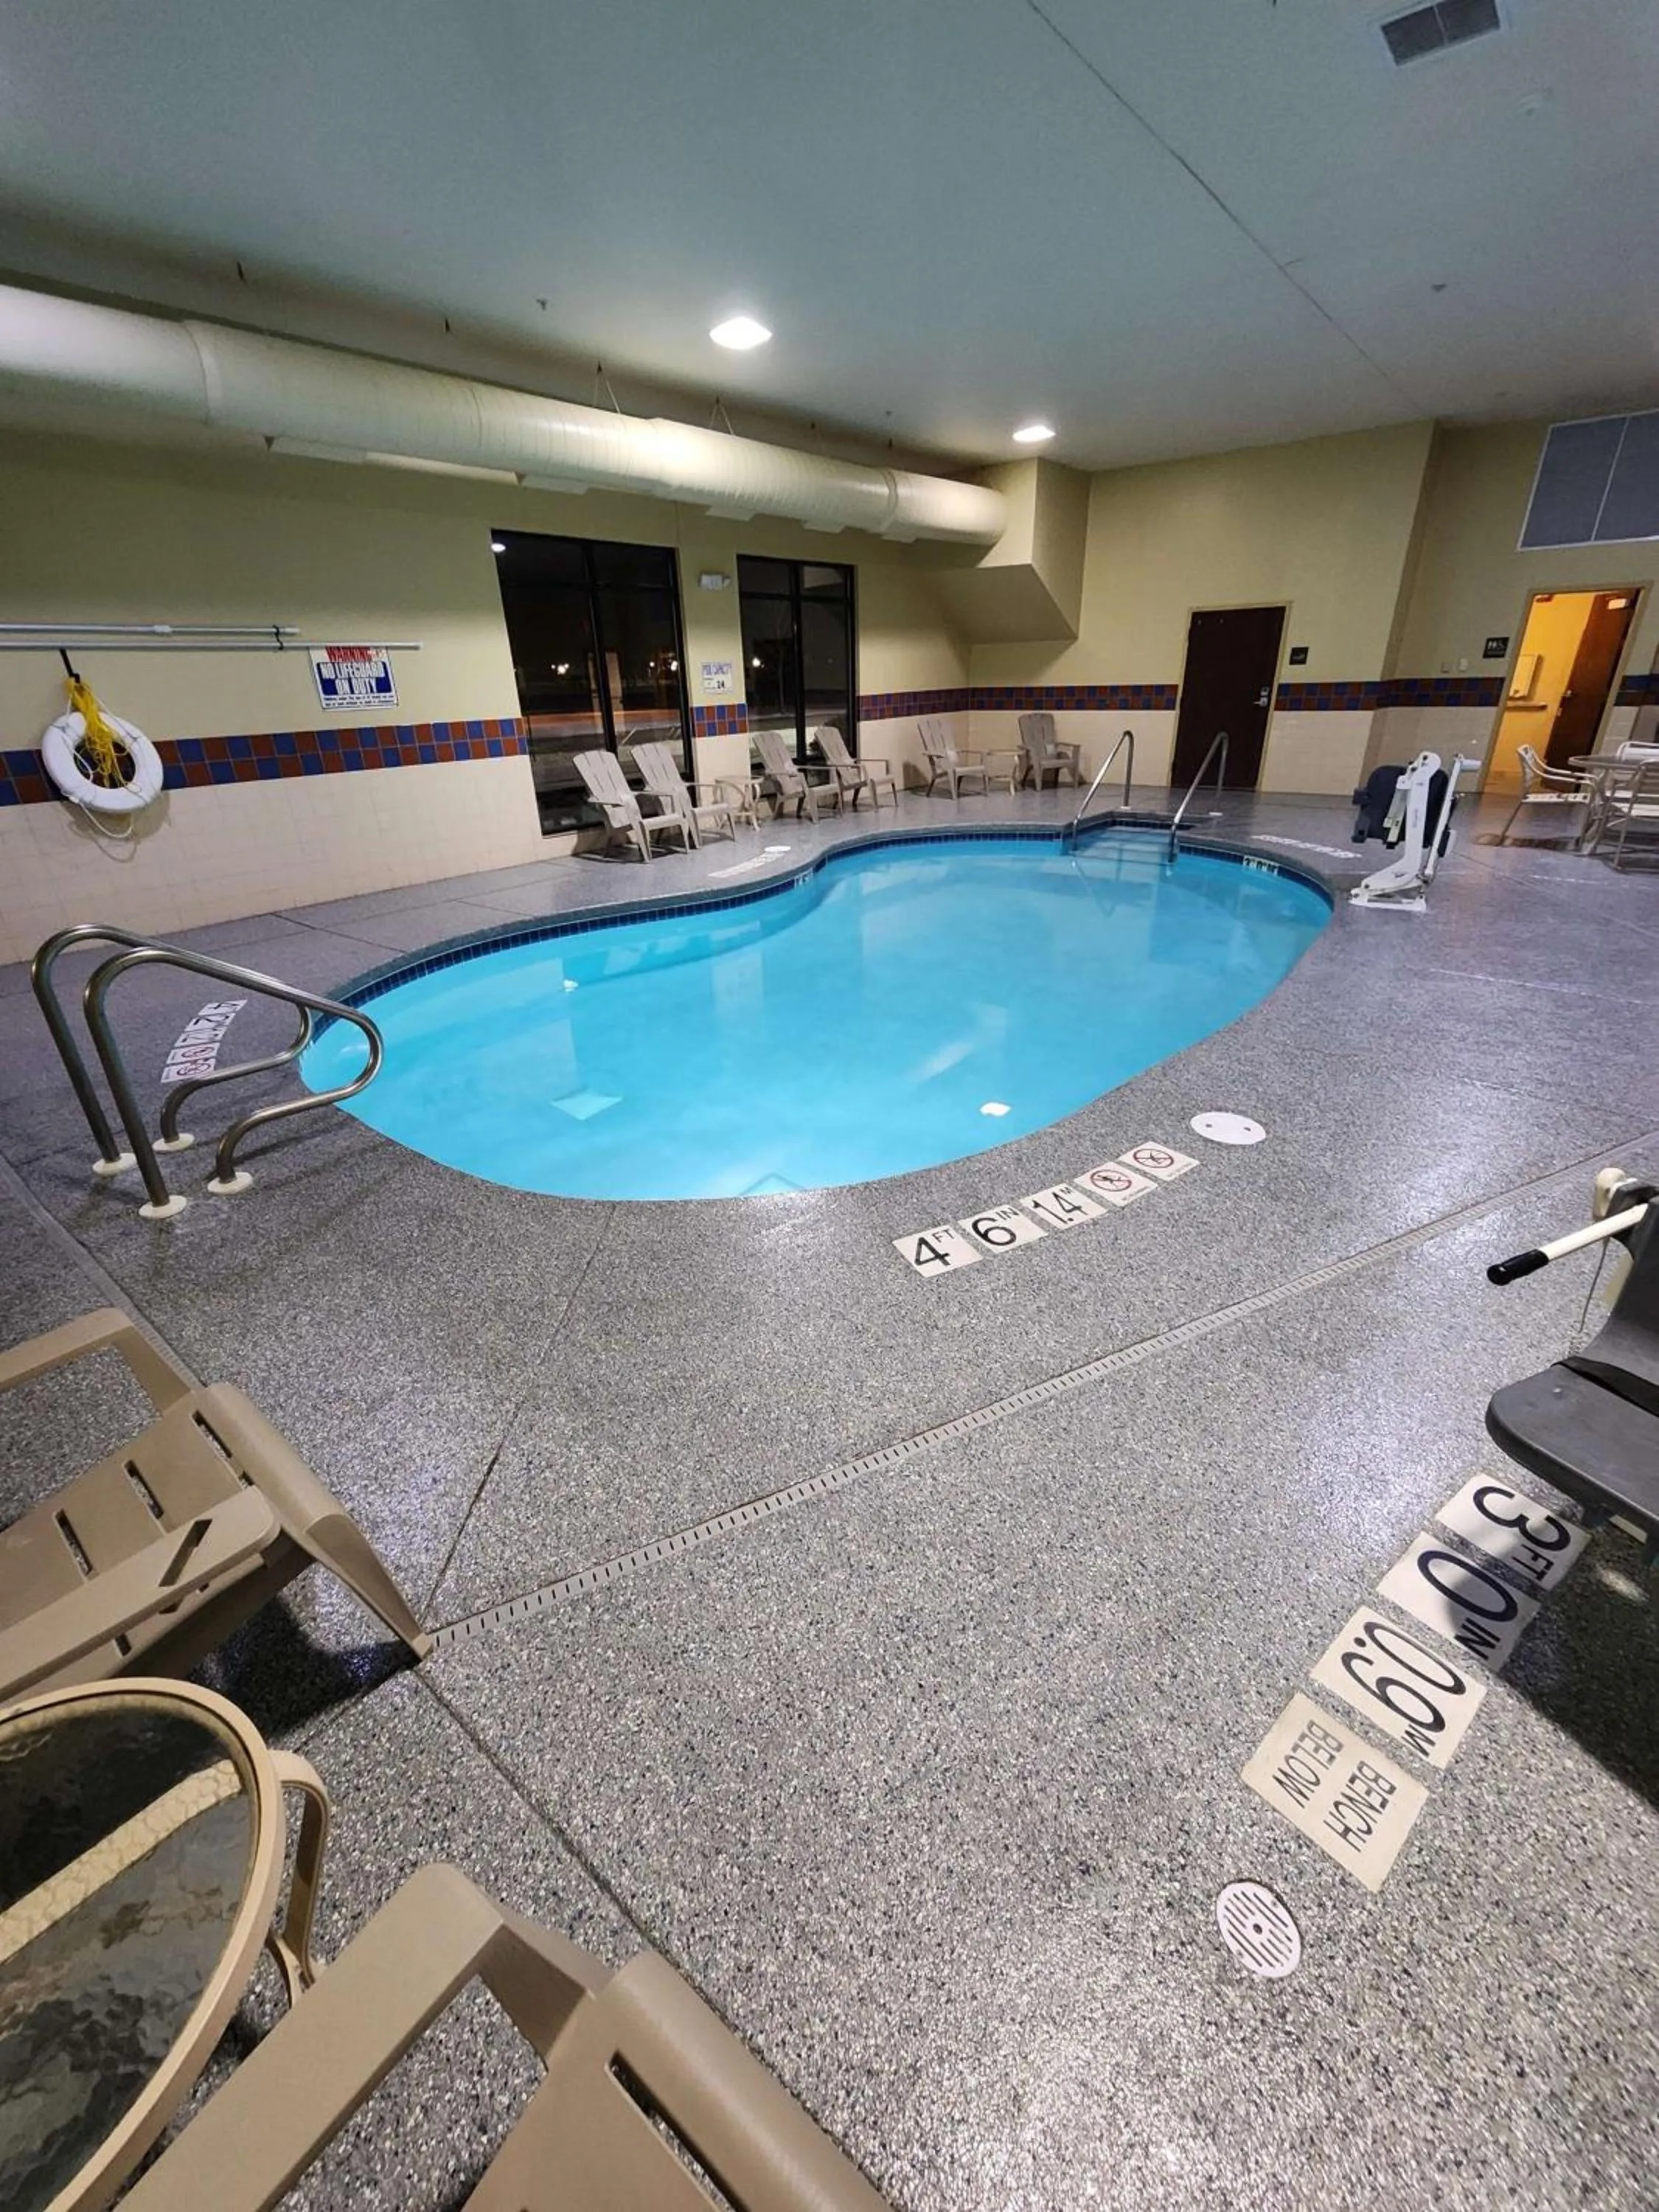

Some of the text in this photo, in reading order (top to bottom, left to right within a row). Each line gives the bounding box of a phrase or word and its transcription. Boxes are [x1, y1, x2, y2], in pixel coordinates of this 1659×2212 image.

[320, 661, 385, 679] NO LIFEGUARD
[335, 678, 377, 695] ON DUTY
[995, 1207, 1020, 1221] IN
[1032, 1191, 1089, 1224] 1.4
[932, 1228, 955, 1243] FT
[971, 1217, 1018, 1246] 6
[914, 1237, 951, 1267] 4
[1472, 1485, 1571, 1551] 3
[1517, 1549, 1554, 1582] FT
[1416, 1550, 1518, 1621] 0
[1455, 1618, 1501, 1660] IN
[1401, 1724, 1436, 1759] M
[1272, 1720, 1344, 1809] BELOW
[1323, 1759, 1397, 1852] BENCH
